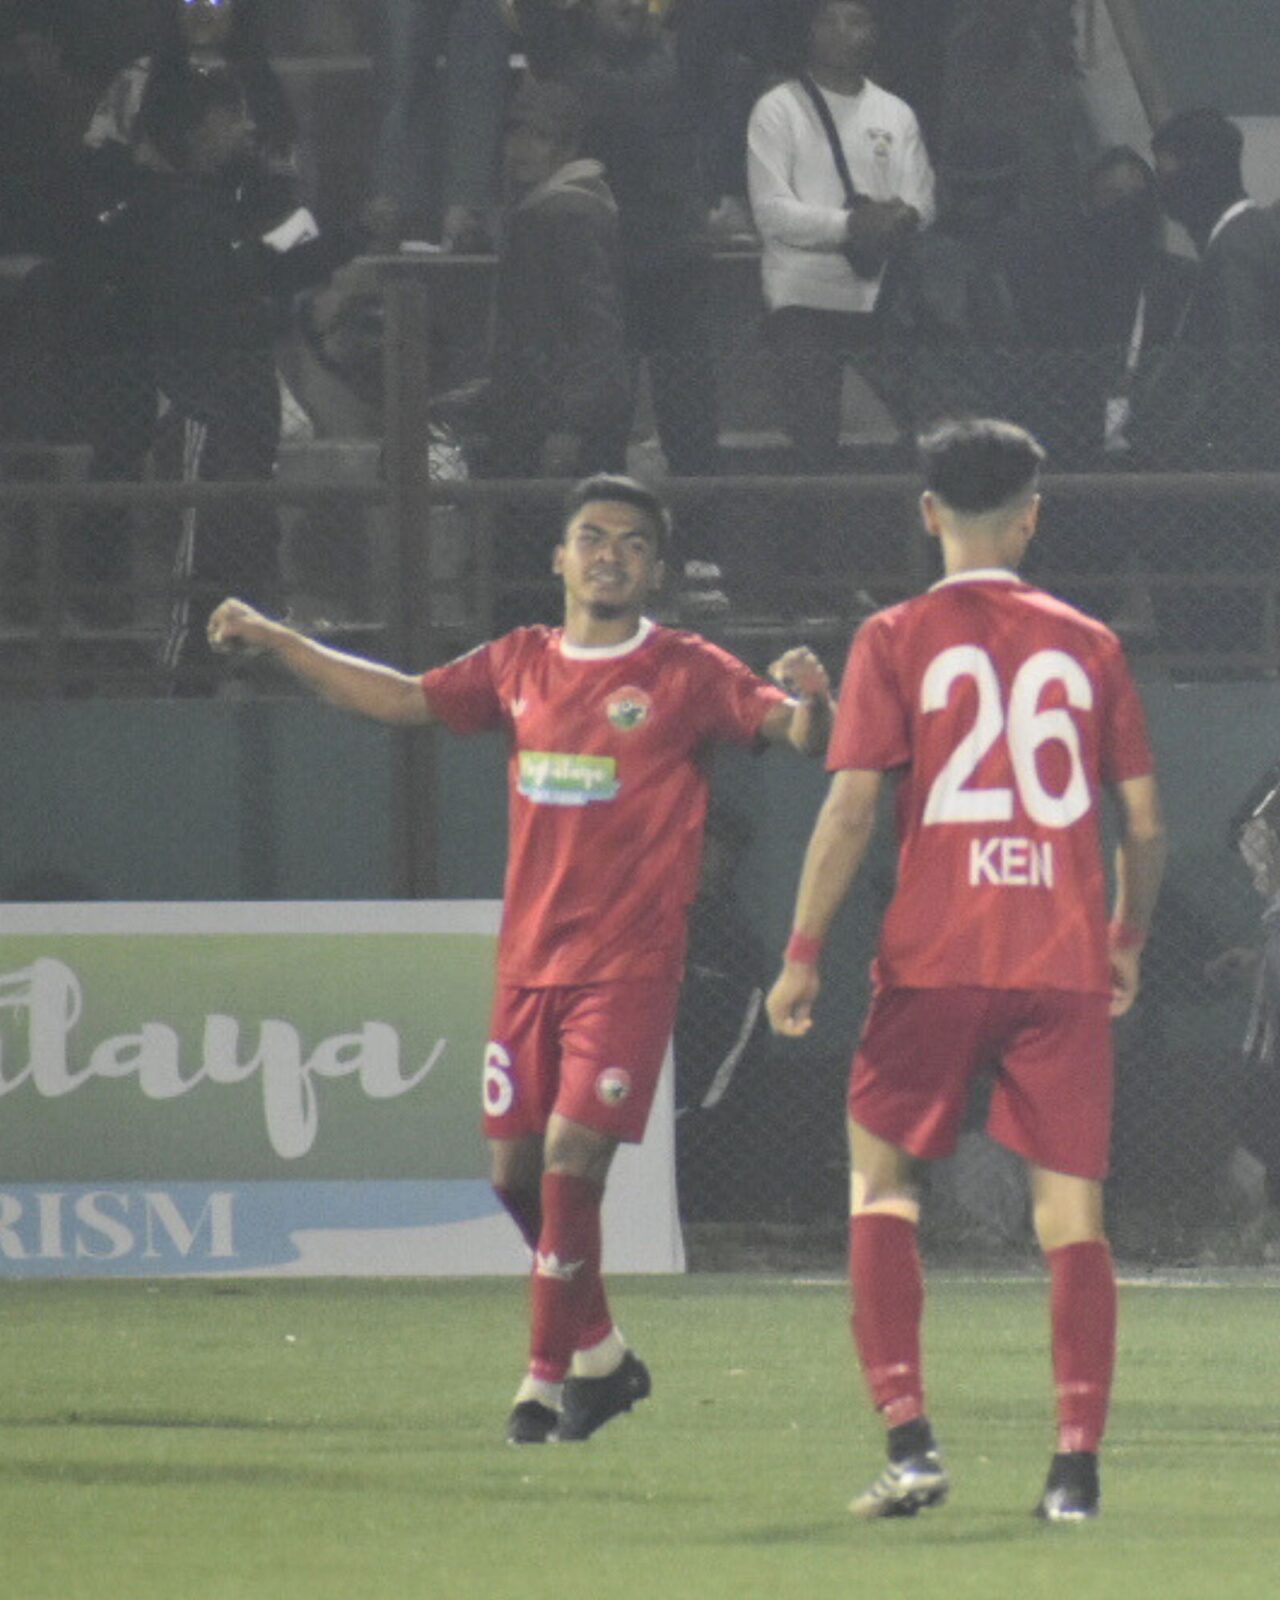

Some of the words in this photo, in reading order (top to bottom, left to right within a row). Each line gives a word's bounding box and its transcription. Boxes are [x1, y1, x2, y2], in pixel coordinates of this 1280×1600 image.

[921, 644, 1093, 829] 26
[969, 836, 1054, 888] KEN
[0, 957, 446, 1158] laya
[482, 1041, 515, 1117] 6
